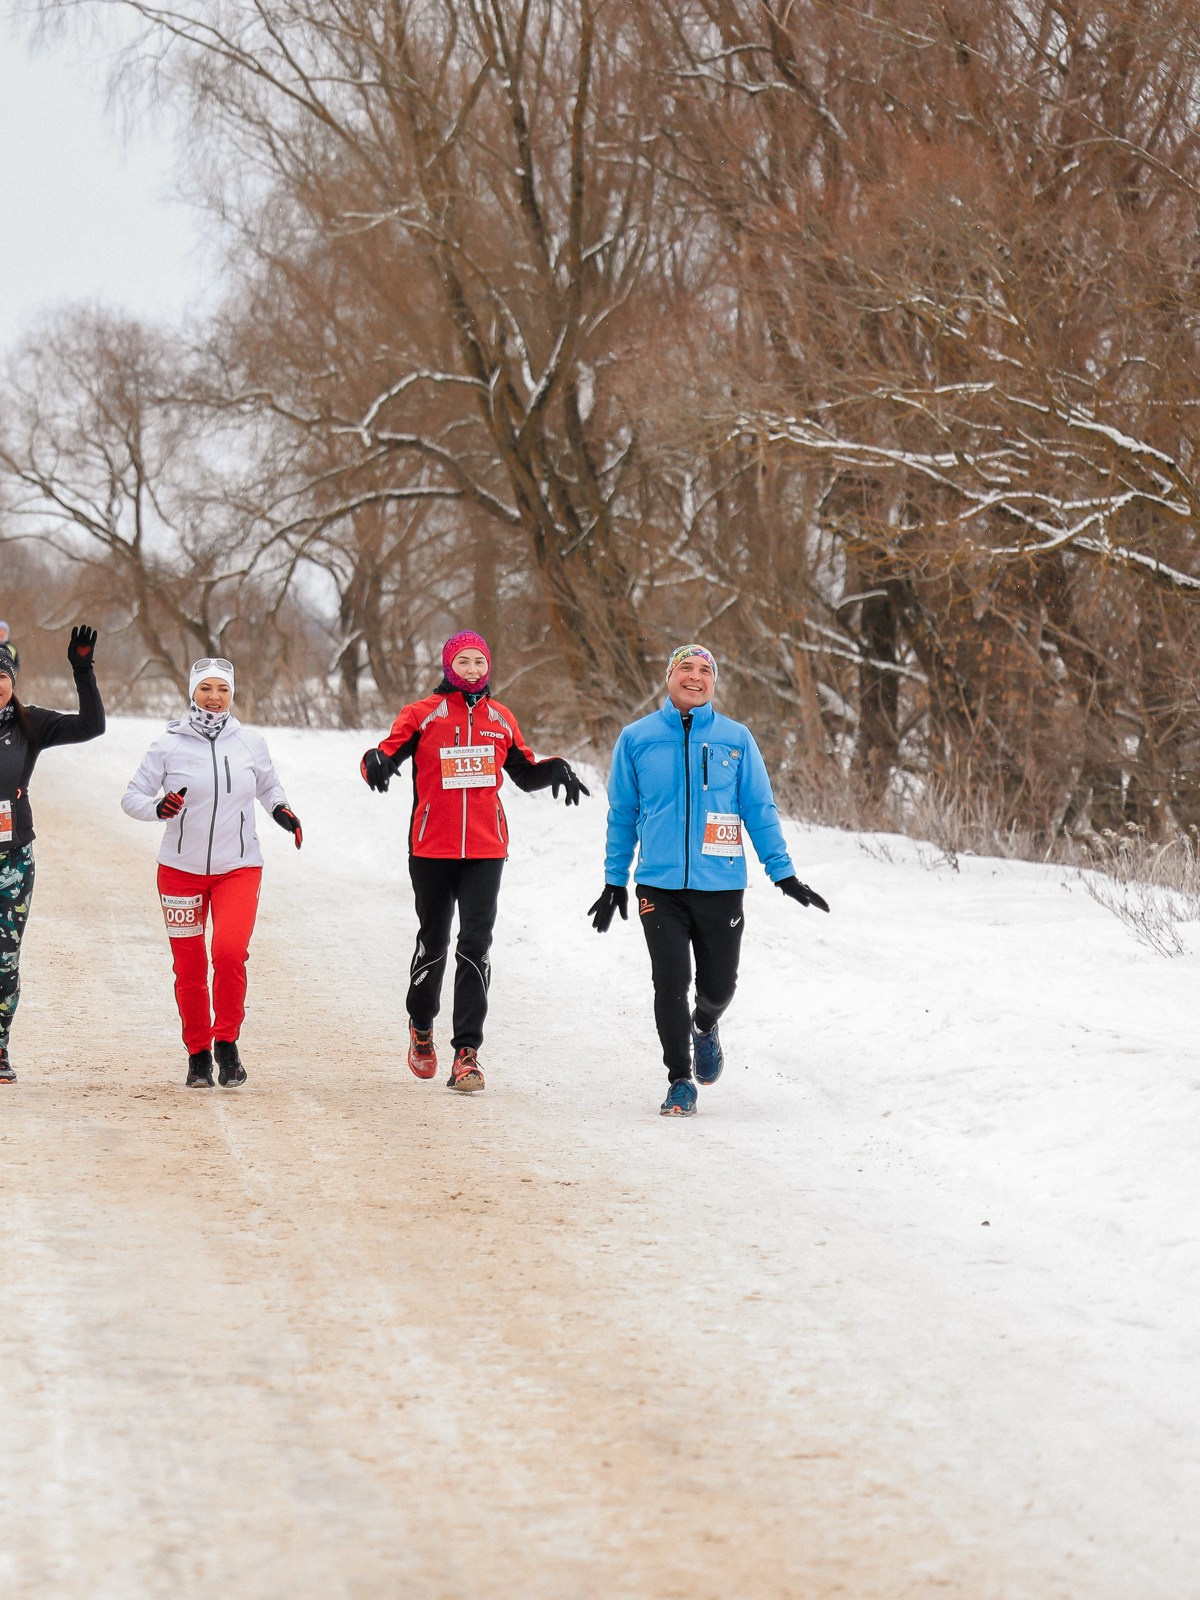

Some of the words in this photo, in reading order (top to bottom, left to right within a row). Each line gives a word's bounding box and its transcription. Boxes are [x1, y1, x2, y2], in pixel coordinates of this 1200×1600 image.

[455, 758, 483, 773] 113
[717, 825, 738, 841] 039
[166, 908, 196, 924] 008
